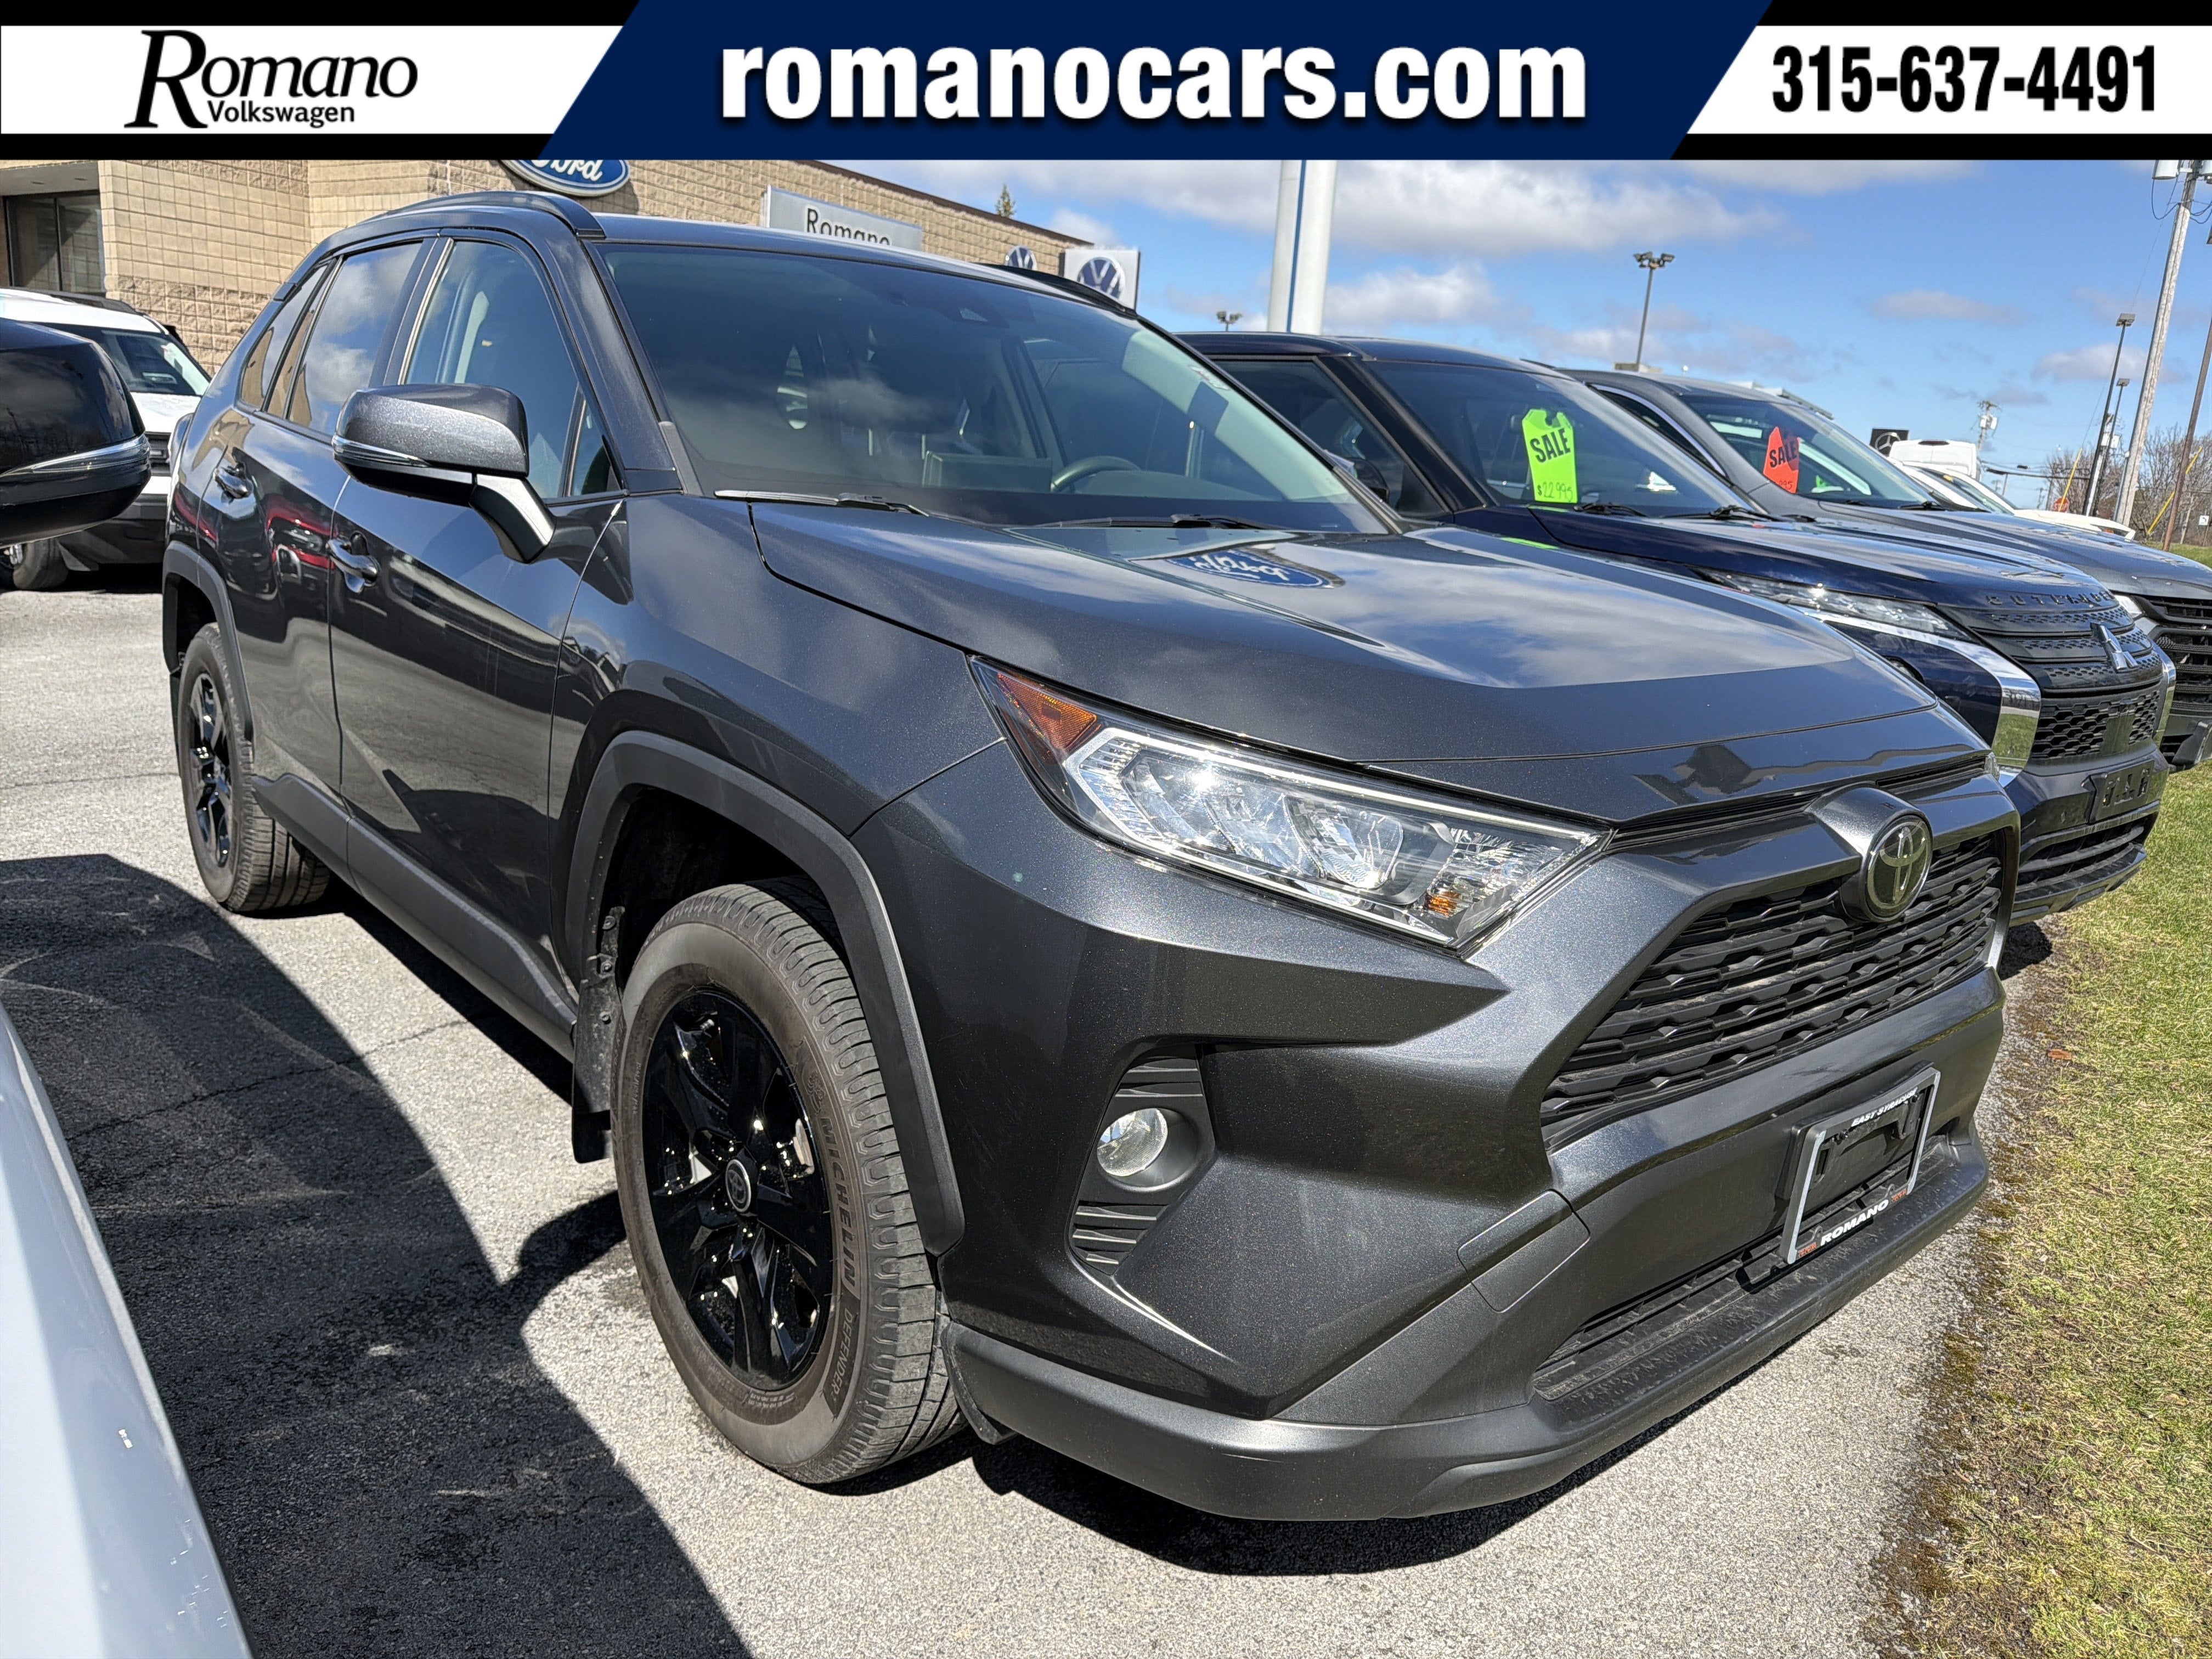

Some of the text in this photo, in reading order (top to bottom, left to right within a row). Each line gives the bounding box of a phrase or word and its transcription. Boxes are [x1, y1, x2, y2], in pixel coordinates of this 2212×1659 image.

[1530, 427, 1571, 462] SALE
[1769, 441, 1797, 468] SALE
[1851, 1110, 1877, 1127] EAST
[820, 1118, 856, 1287] MICHELIN
[1820, 1199, 1889, 1246] ROMANO
